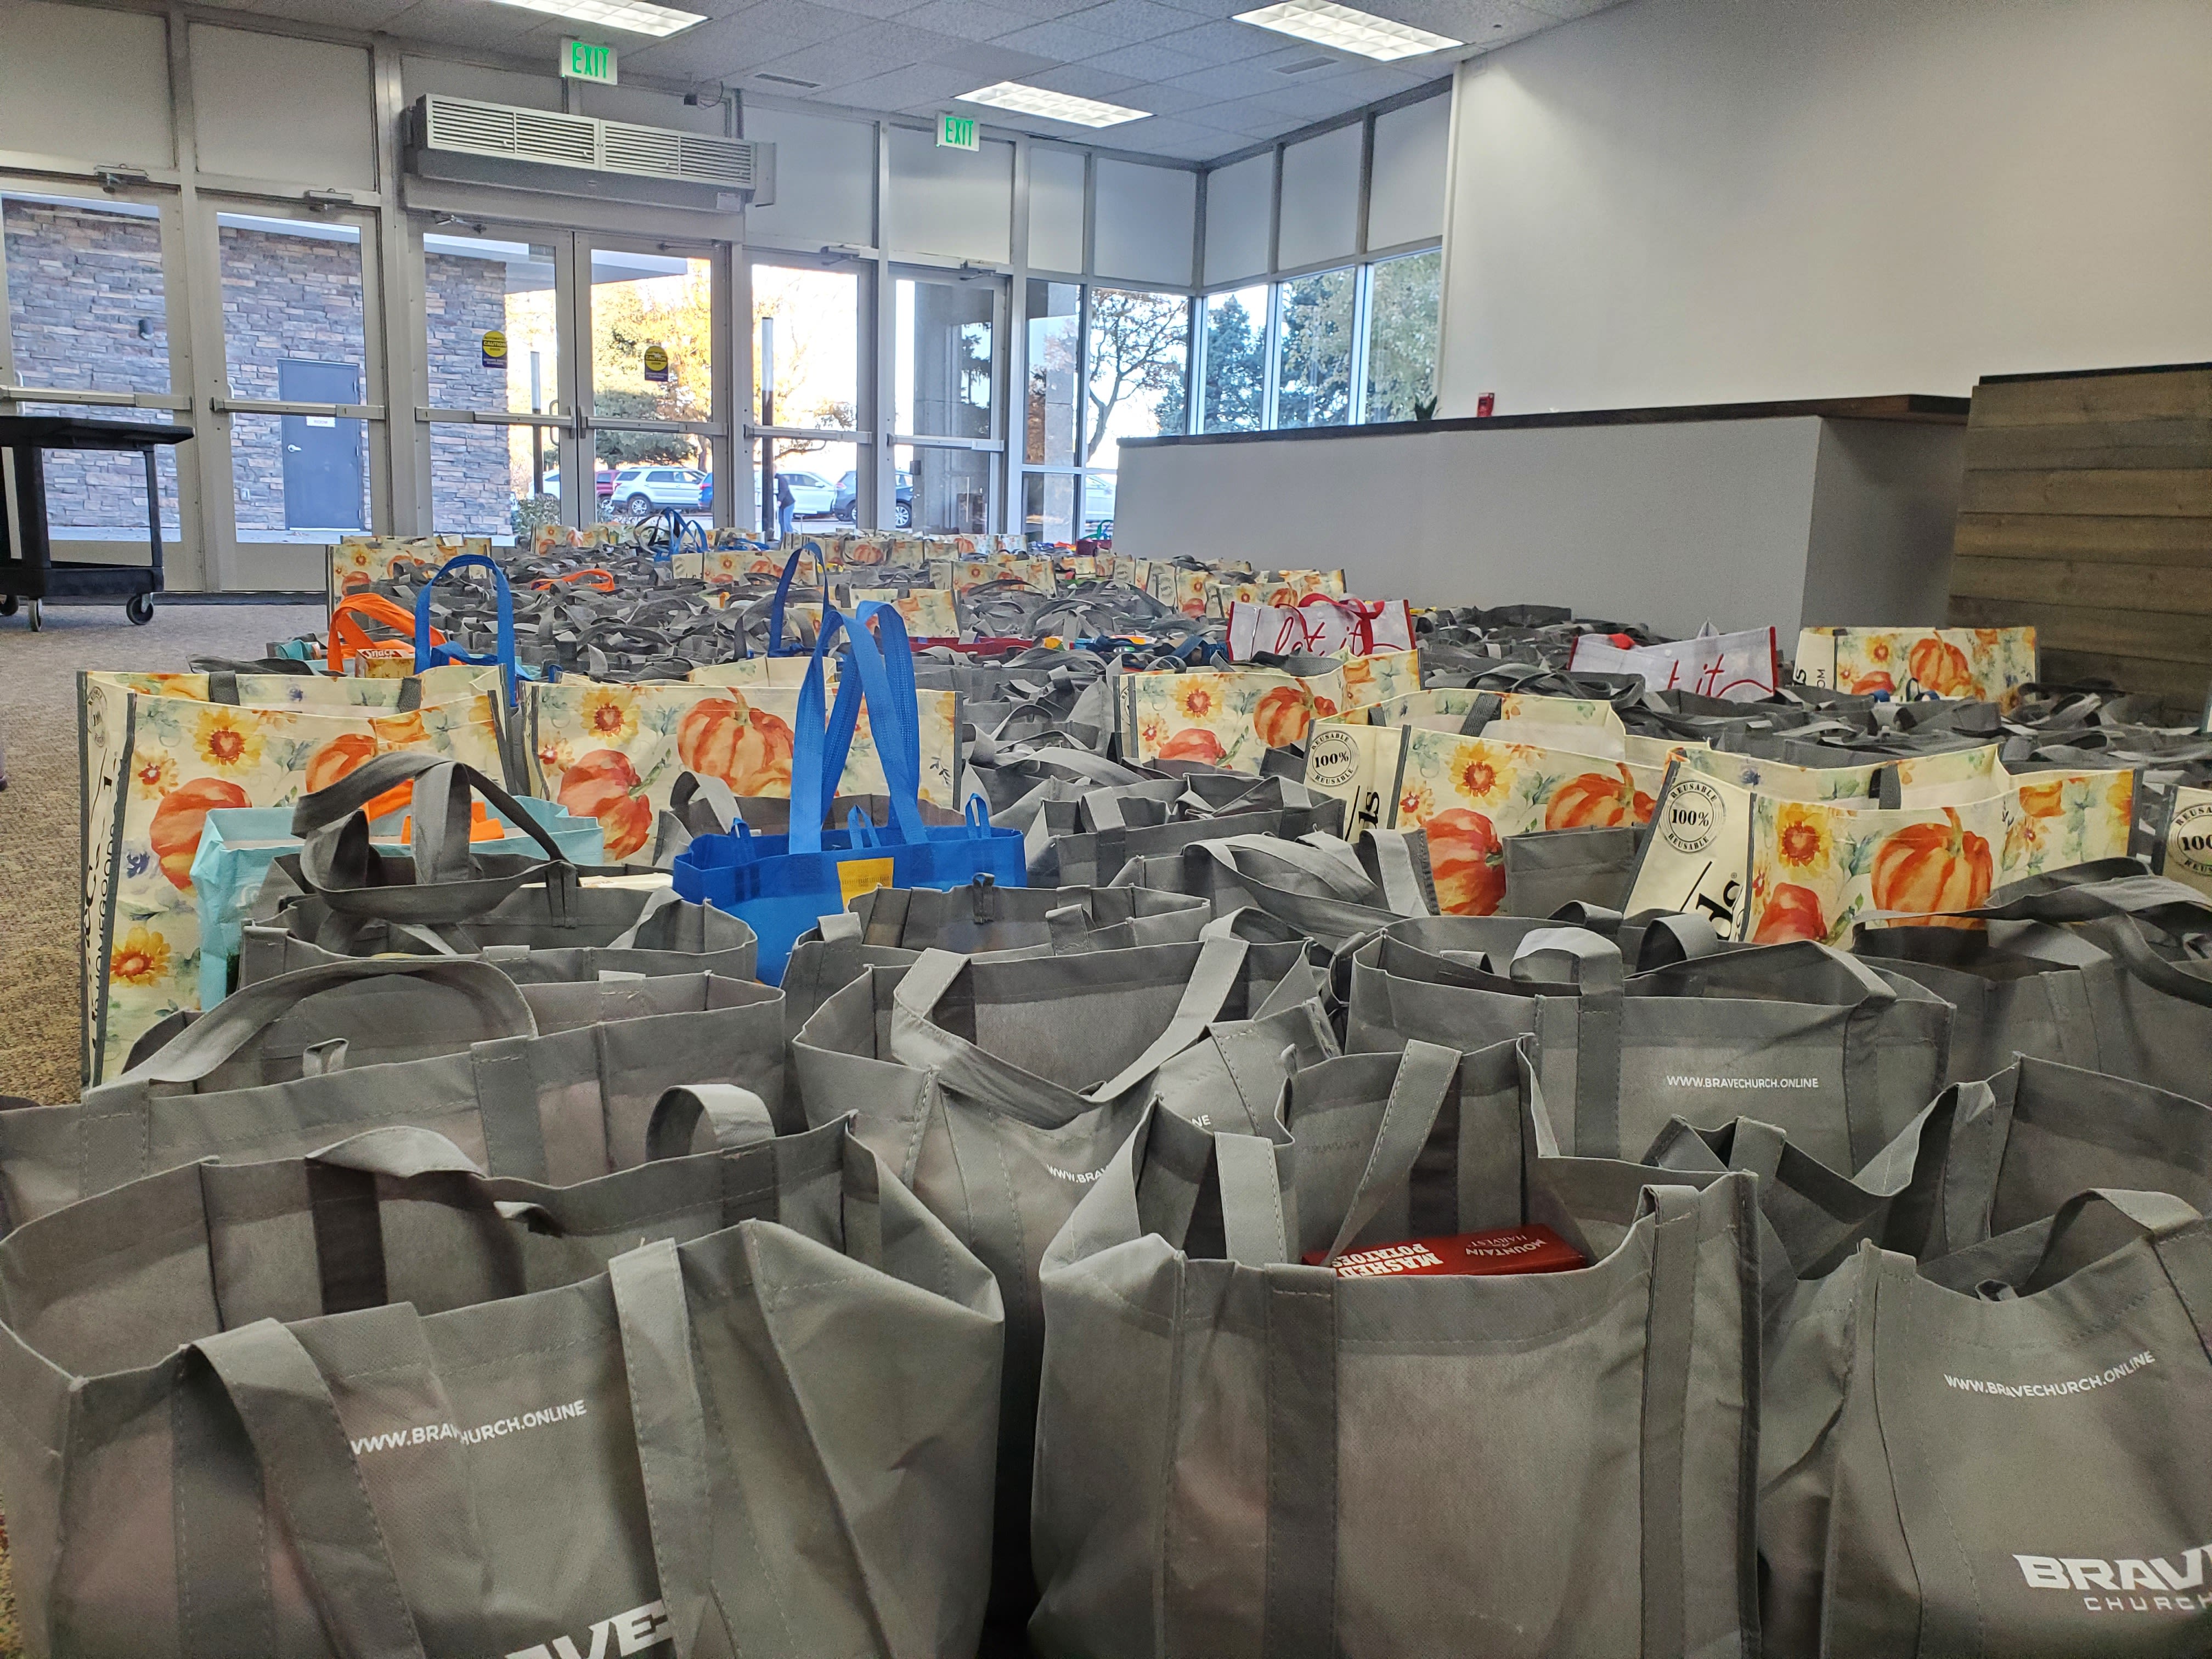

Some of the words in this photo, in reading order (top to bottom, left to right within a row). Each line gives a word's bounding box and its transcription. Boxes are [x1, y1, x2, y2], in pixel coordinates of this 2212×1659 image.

[572, 42, 609, 78] EXIT
[945, 117, 973, 146] EXIT
[1311, 733, 1350, 751] REUSABLE
[1315, 751, 1349, 768] 100%
[1315, 768, 1353, 785] REUSABLE
[1670, 783, 1718, 802] REUSABLE
[1672, 809, 1709, 827] 100%
[2176, 806, 2212, 826] REUSA
[1668, 833, 1709, 850] REUSABLE
[1666, 1075, 1819, 1089] WWW.BRAVECHURCH.ONLINE
[1465, 1239, 1547, 1256] MOUNTAIN
[1471, 1234, 1528, 1247] HARVEST
[1331, 1243, 1430, 1268] POTATOES
[1338, 1252, 1444, 1278] MASHED
[1944, 1351, 2155, 1398] WWW.BRAVECHURCH.ONLINE
